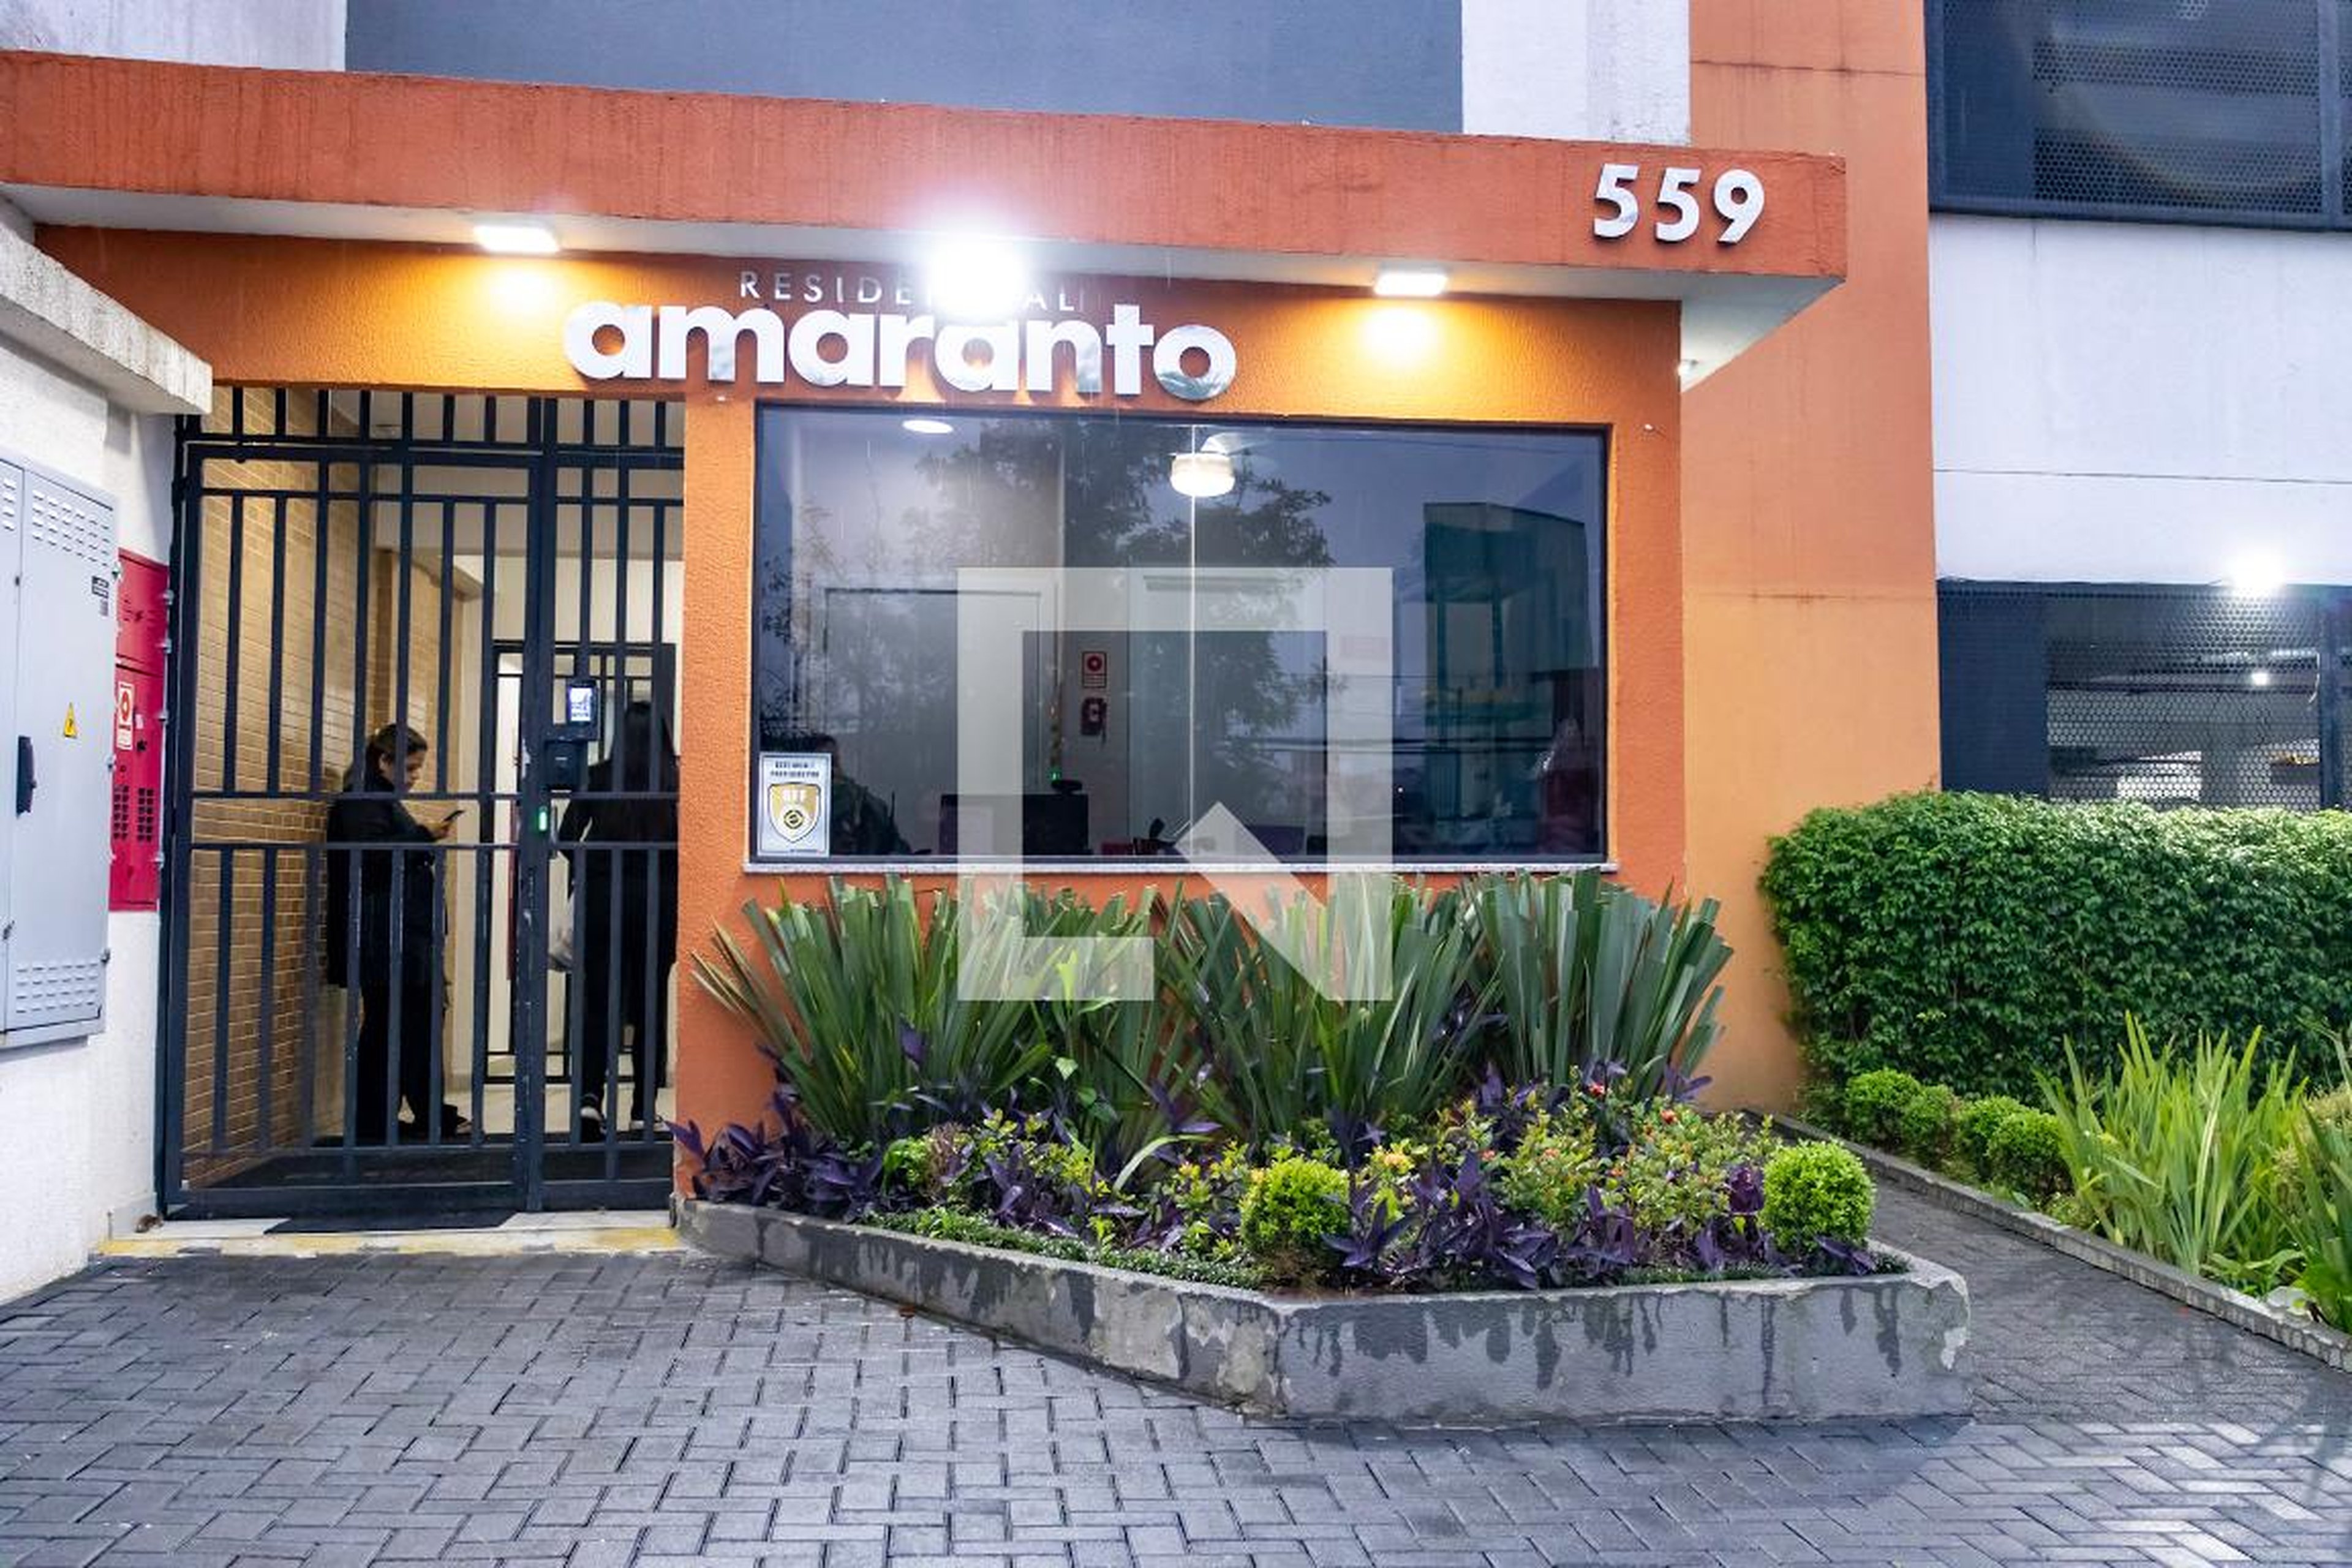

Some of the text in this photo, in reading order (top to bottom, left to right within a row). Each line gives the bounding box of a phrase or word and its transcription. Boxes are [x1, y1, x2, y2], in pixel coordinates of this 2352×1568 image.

[1593, 163, 1765, 243] 559
[740, 271, 1074, 311] RESIDEAL
[564, 301, 1237, 401] amaranto
